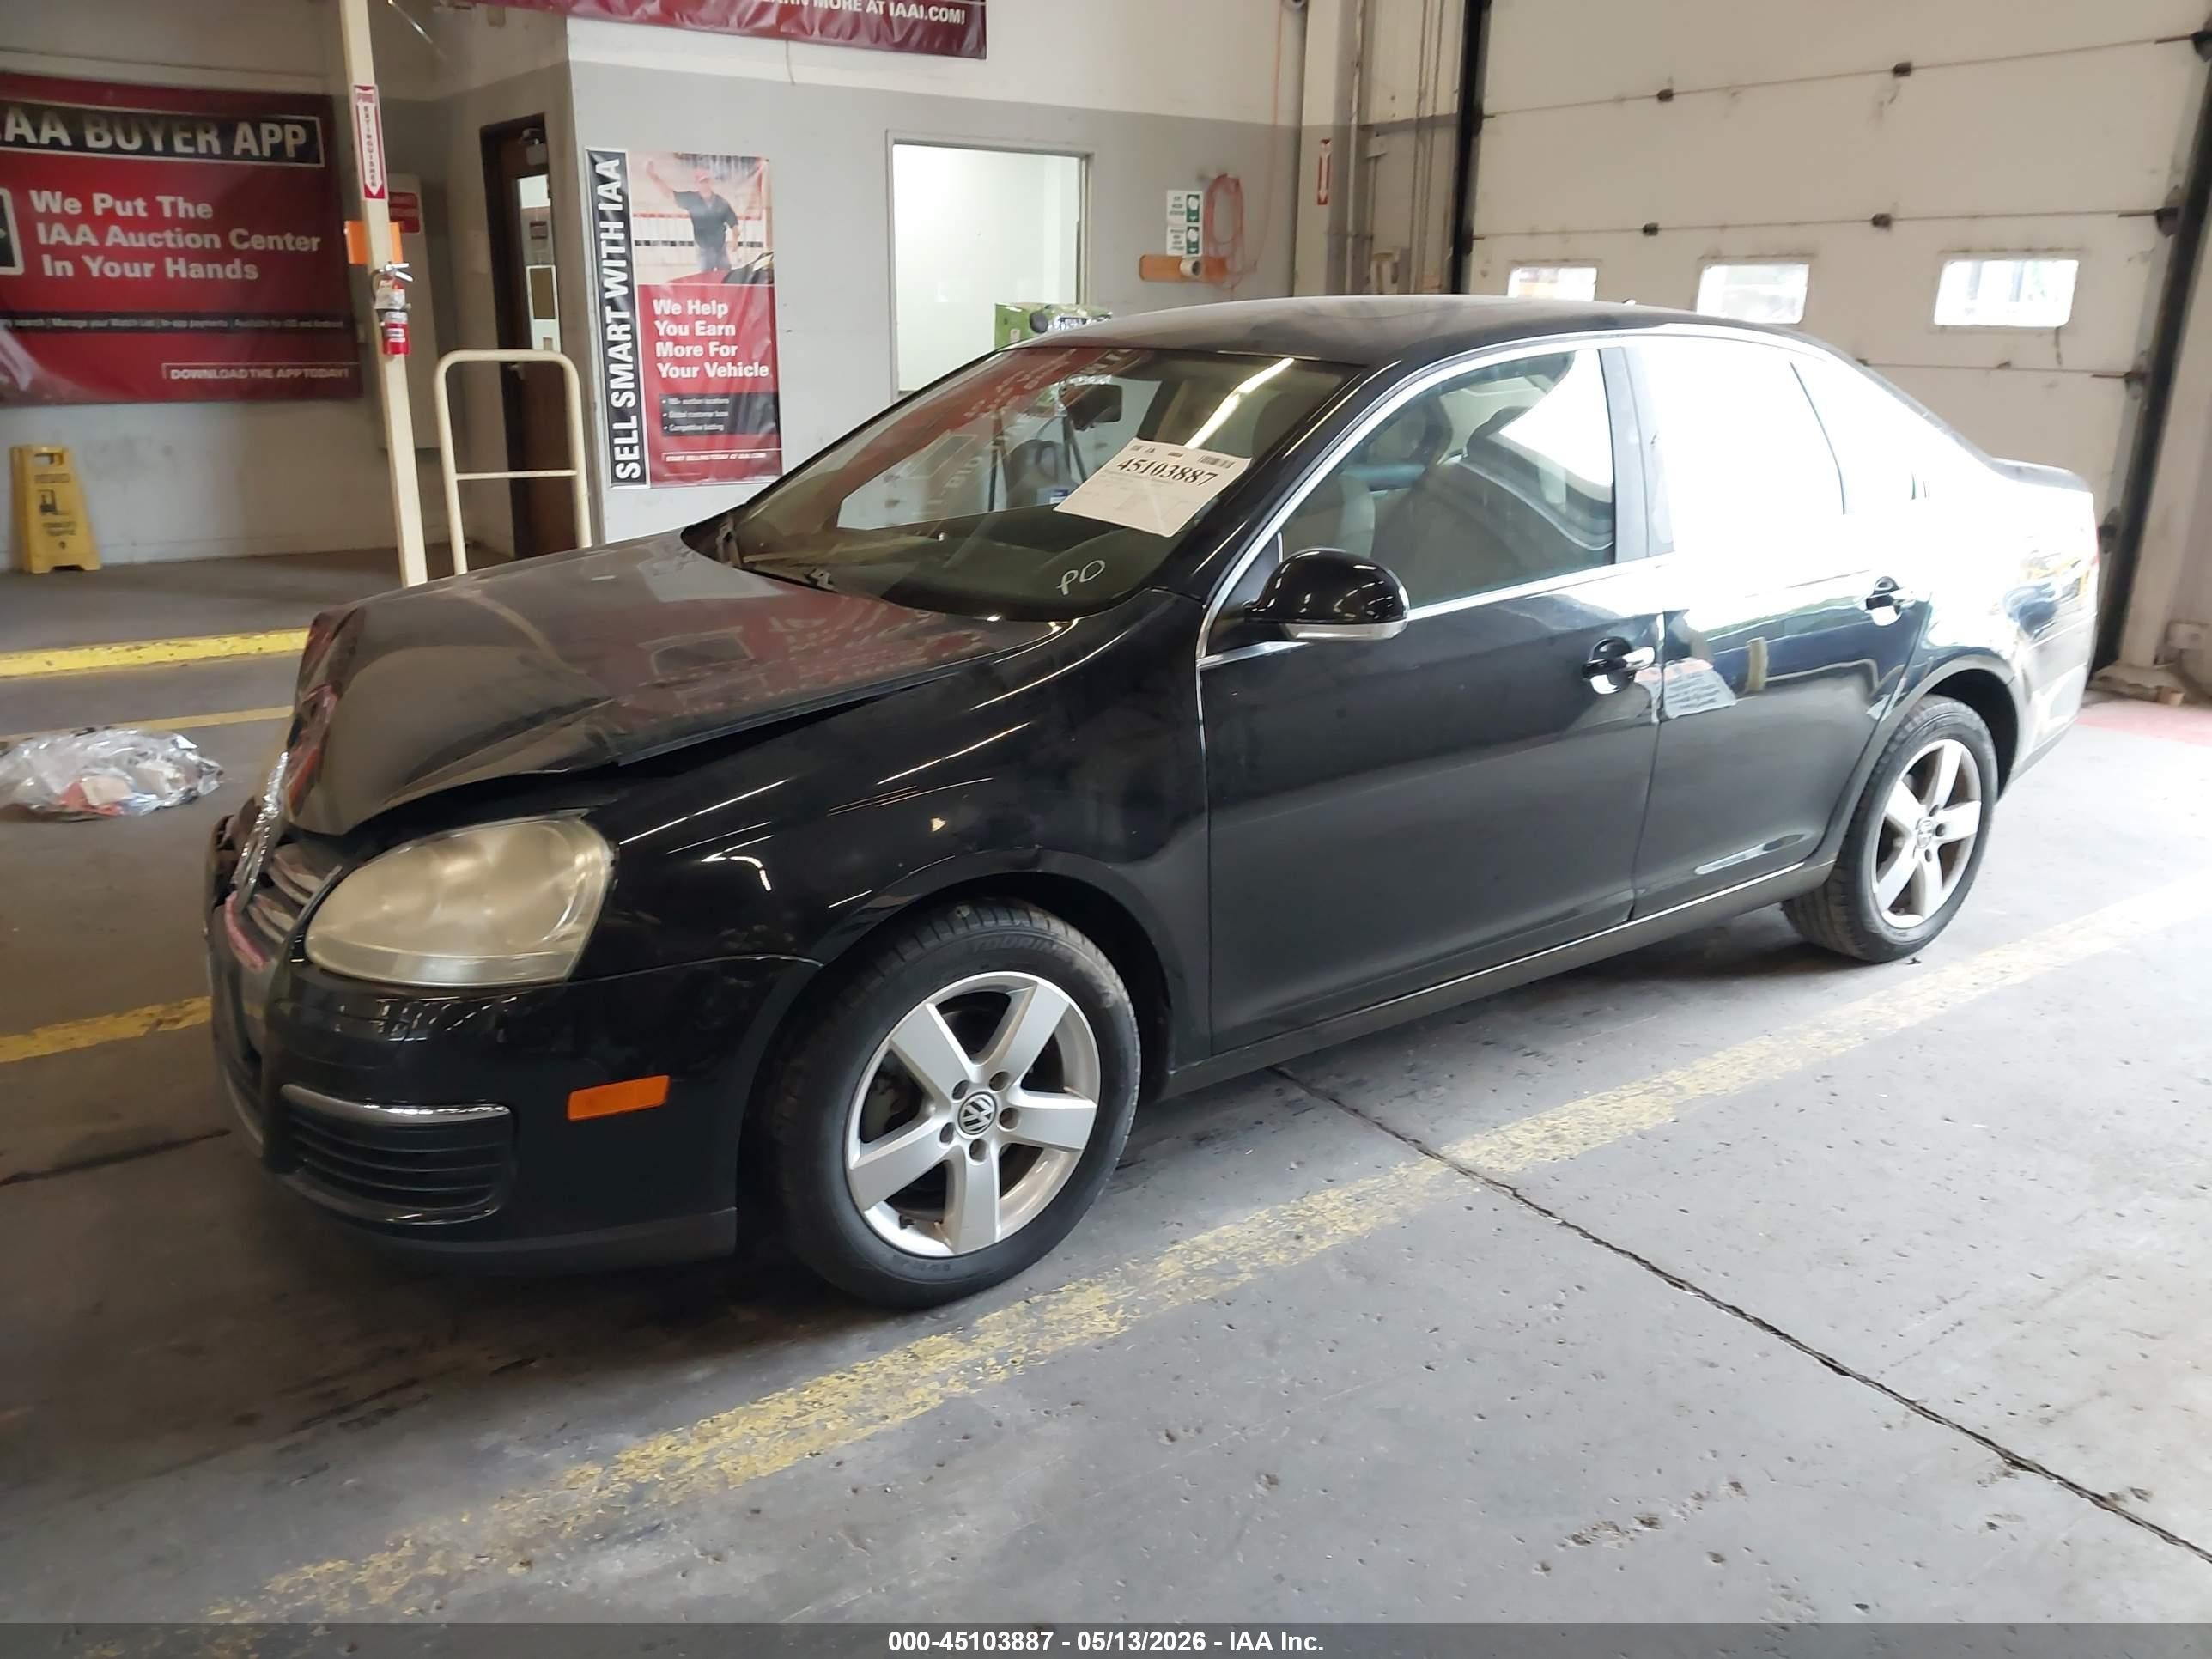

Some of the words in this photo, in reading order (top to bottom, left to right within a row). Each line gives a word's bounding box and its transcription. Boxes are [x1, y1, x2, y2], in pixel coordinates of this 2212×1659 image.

[812, 0, 862, 12] MORE
[866, 3, 885, 15] AT
[890, 4, 966, 25] IAAI.COM!
[0, 105, 73, 147] AA
[86, 114, 222, 155] BUYER
[233, 122, 307, 158] APP
[595, 158, 623, 211] IAA
[29, 190, 83, 215] We
[92, 193, 149, 216] Put
[155, 195, 214, 219] The
[37, 222, 99, 246] IAA
[105, 225, 222, 249] Auction
[228, 228, 322, 252] Center
[41, 254, 75, 276] In
[82, 256, 155, 278] Your
[164, 258, 259, 280] Hands
[599, 221, 629, 299] WITH
[653, 299, 683, 315] We
[687, 299, 729, 319] Help
[654, 320, 690, 336] You
[695, 320, 736, 336] Earn
[605, 305, 636, 408] SMART
[655, 342, 704, 357] More
[708, 342, 738, 357] For
[277, 368, 302, 379] APP
[657, 362, 700, 378] Your
[704, 362, 769, 378] Vehicle
[612, 415, 641, 479] SELL
[1117, 457, 1219, 486] 45103887
